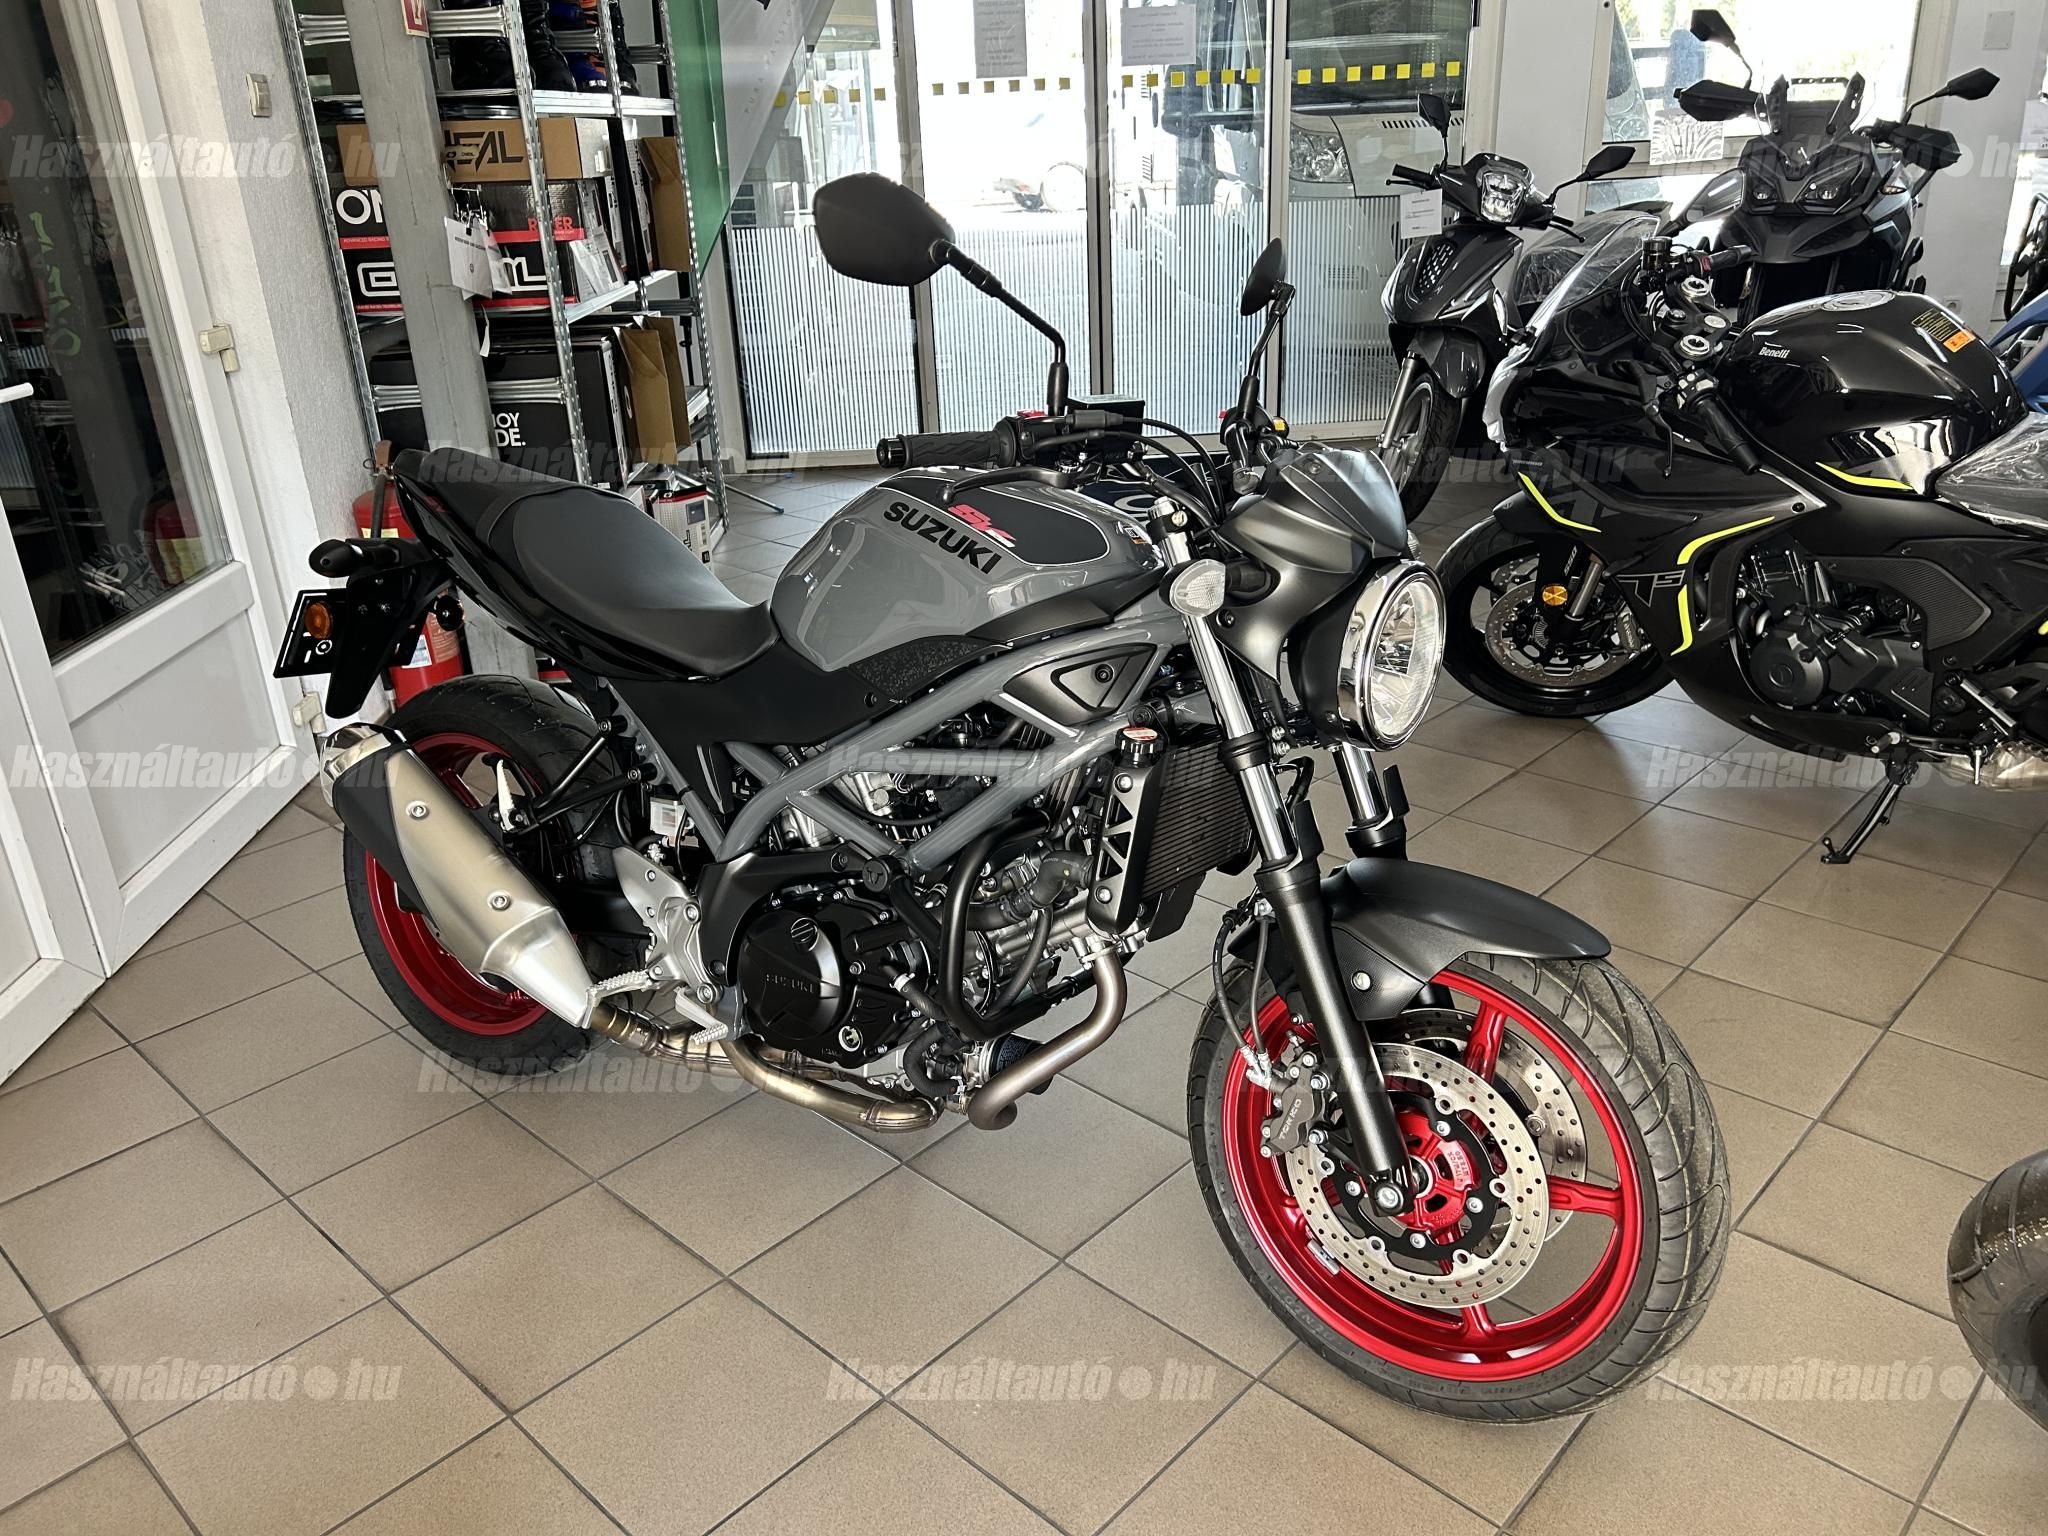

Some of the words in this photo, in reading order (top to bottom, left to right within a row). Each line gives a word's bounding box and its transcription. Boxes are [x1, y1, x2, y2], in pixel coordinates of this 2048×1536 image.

[1758, 346, 1790, 359] Benelli
[883, 501, 1002, 575] SUZUKI
[1279, 1098, 1302, 1141] TOKICO
